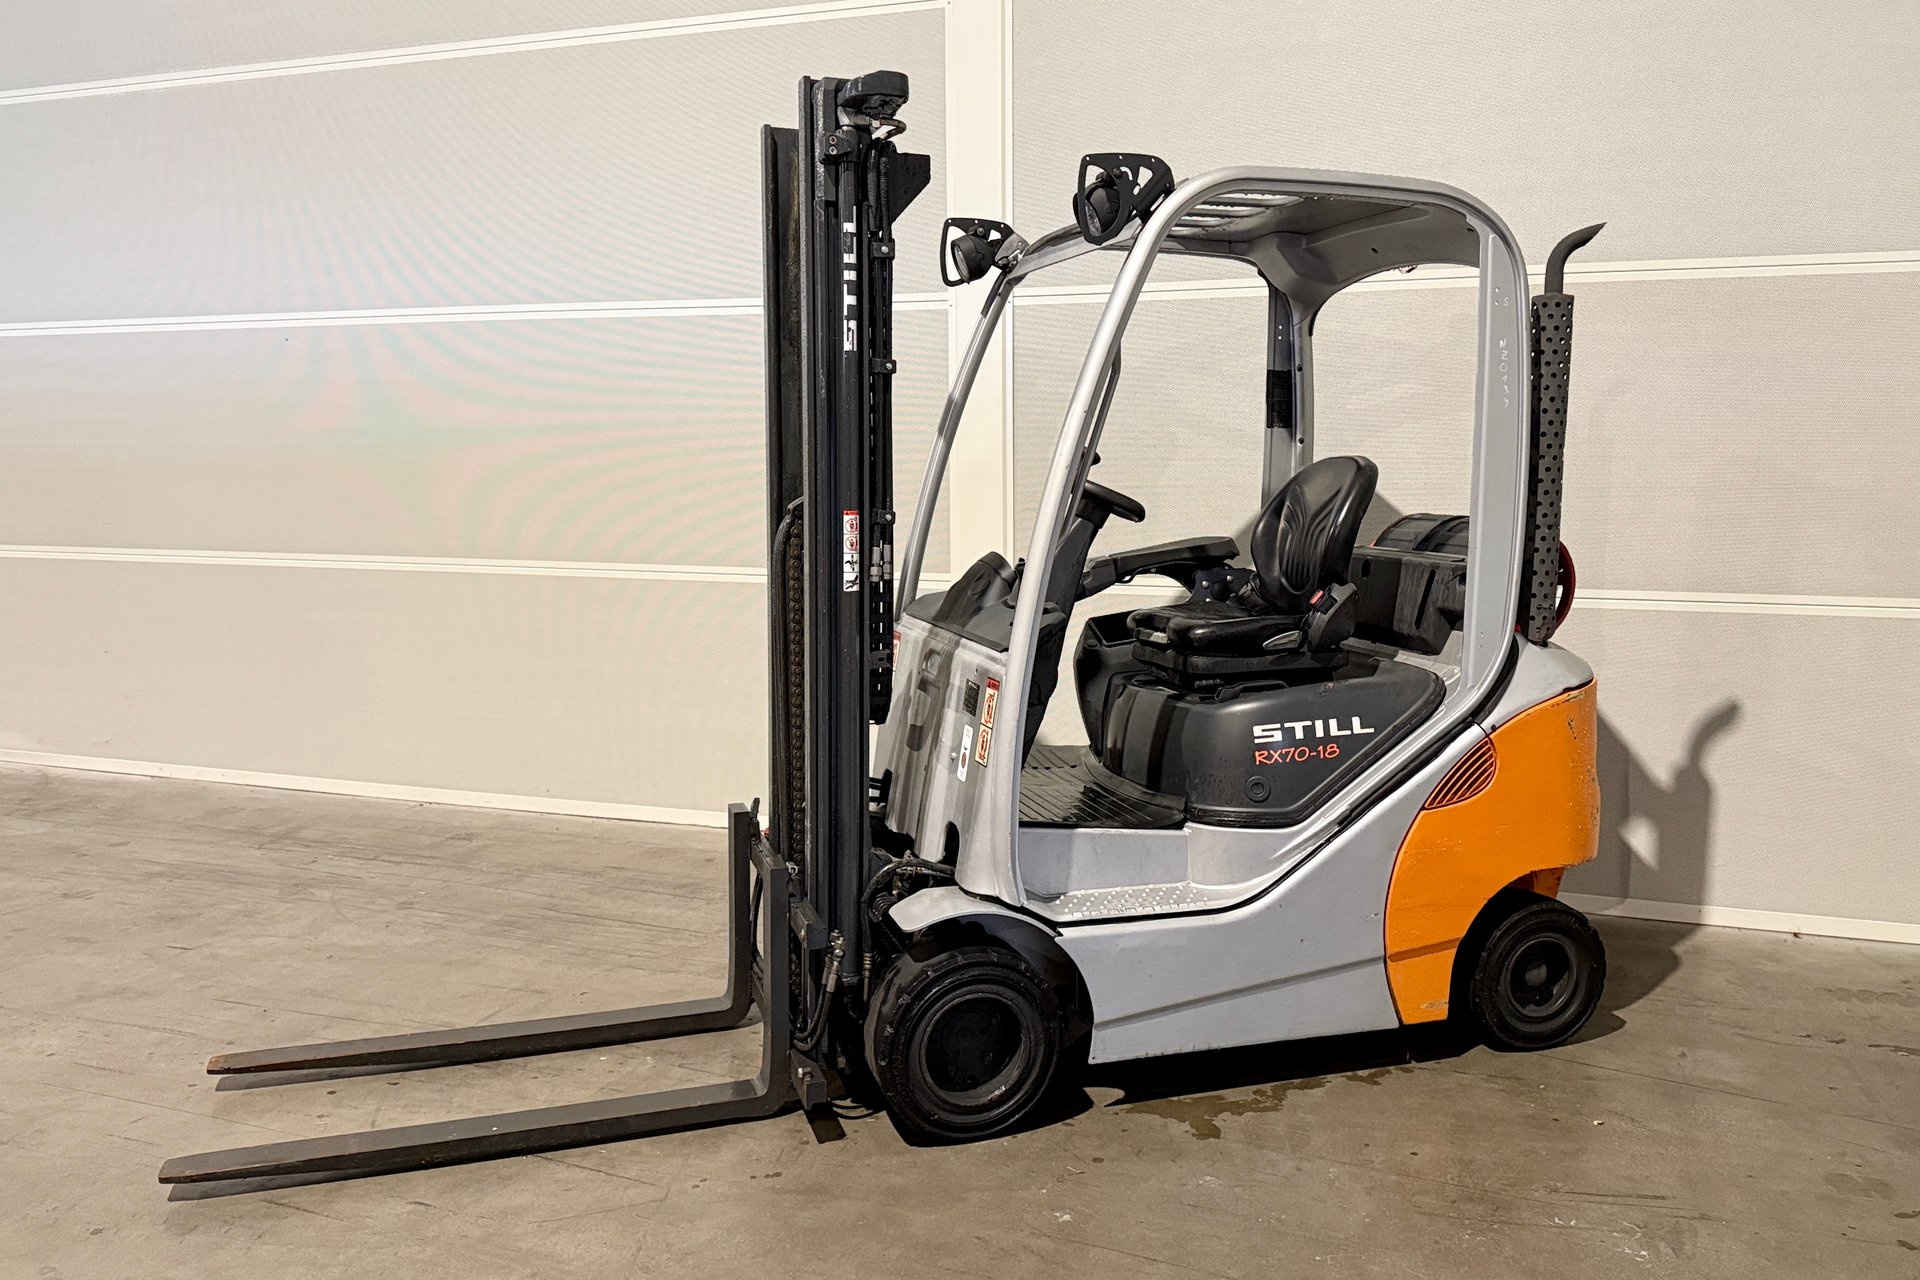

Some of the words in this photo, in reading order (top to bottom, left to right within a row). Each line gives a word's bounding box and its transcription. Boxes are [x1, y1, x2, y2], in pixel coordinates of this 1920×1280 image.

[842, 205, 858, 352] STILL
[1252, 716, 1375, 744] STILL
[1254, 743, 1341, 766] RX70-18
